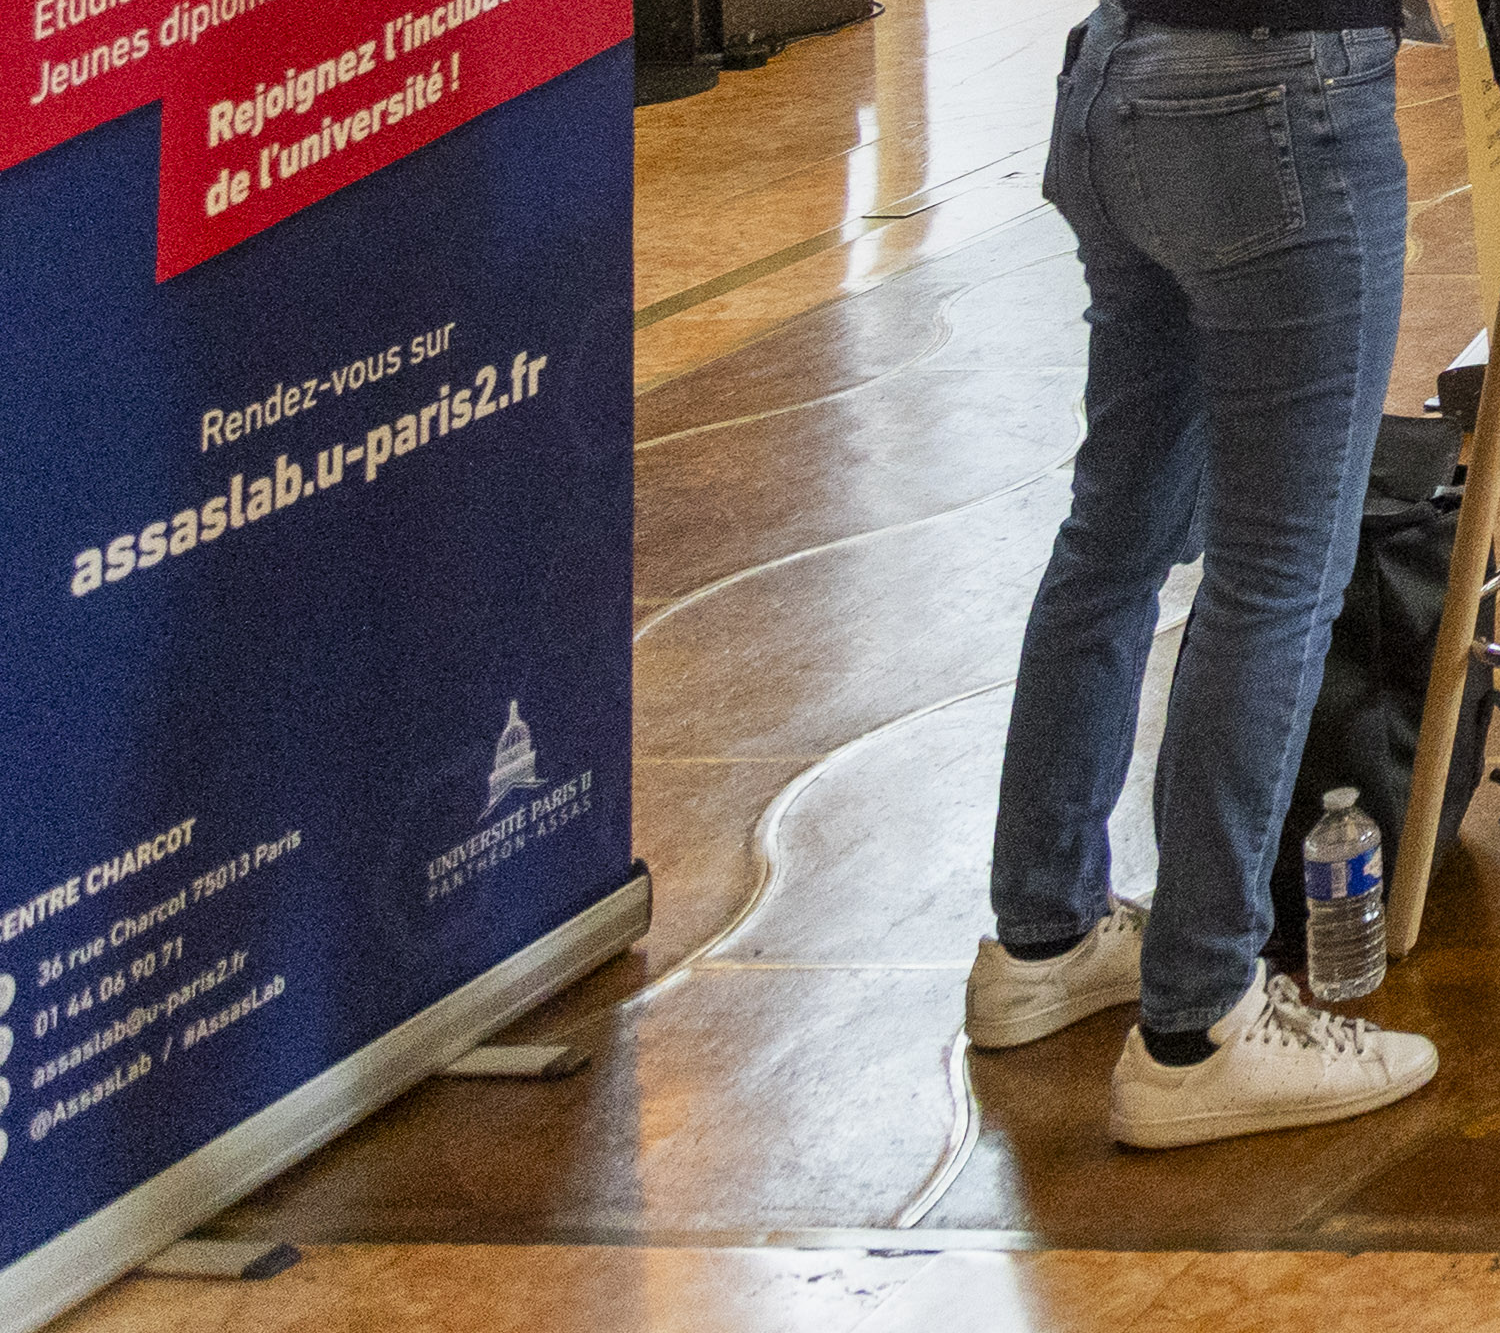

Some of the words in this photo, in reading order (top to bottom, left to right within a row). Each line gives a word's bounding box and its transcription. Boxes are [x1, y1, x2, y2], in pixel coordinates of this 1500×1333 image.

[31, 24, 149, 106] Jeunes
[207, 38, 376, 148] Rejoignez
[205, 166, 250, 217] de
[259, 66, 443, 191] l'université
[201, 343, 402, 453] Rendez-vous
[410, 322, 455, 361] sur
[71, 351, 547, 598] assaslab.u-paris2.fr
[531, 780, 577, 821] PARIS
[37, 955, 64, 988] 36
[68, 937, 106, 971] rue
[110, 893, 188, 947] Charcot
[191, 852, 250, 903] 75013
[253, 829, 302, 872] Paris
[86, 818, 197, 896] CHARCOT
[32, 949, 249, 1090] assaslab@u-paris2.fr
[34, 1005, 59, 1039] 01
[29, 1052, 153, 1142] @AssasLab
